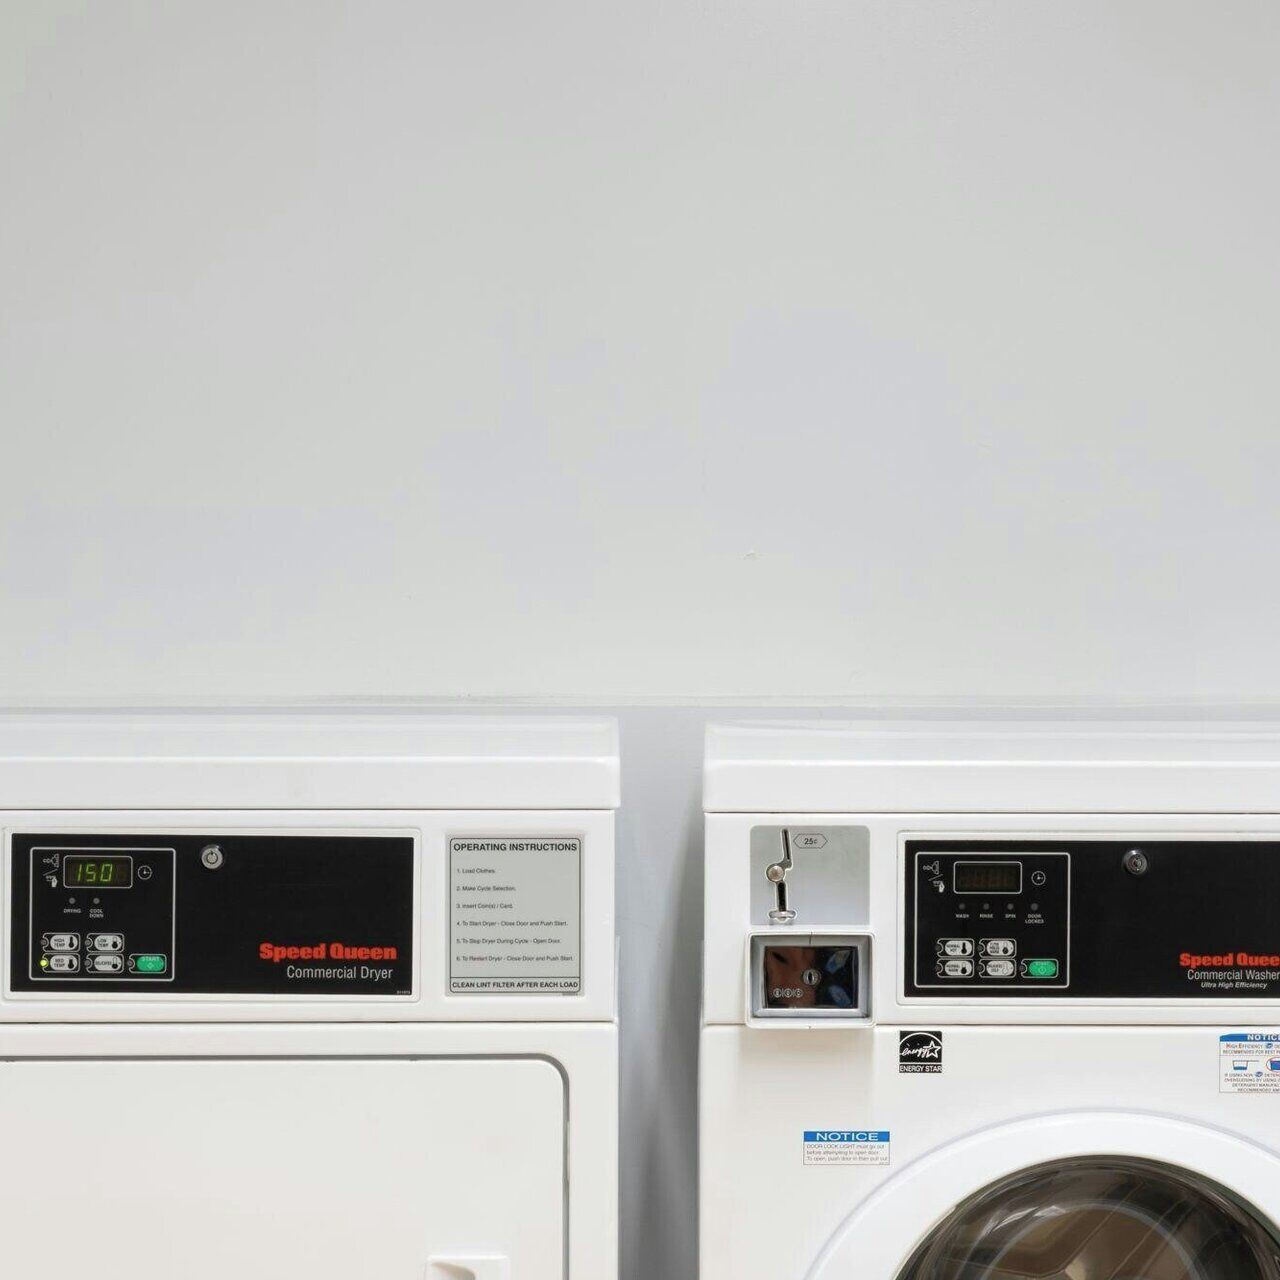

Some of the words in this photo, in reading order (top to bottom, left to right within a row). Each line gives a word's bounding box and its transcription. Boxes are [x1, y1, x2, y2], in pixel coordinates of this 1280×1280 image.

[454, 843, 506, 851] OPERATING
[509, 843, 577, 851] INSTRUCTIONS
[76, 864, 113, 882] 150
[259, 942, 327, 962] Speed
[330, 942, 397, 960] Queen
[1180, 952, 1234, 968] Speed
[286, 965, 357, 979] Commercial
[360, 966, 394, 981] Dryer
[1187, 969, 1242, 980] Commercial
[1245, 970, 1280, 980] Washer
[816, 1132, 878, 1141] NOTICE
